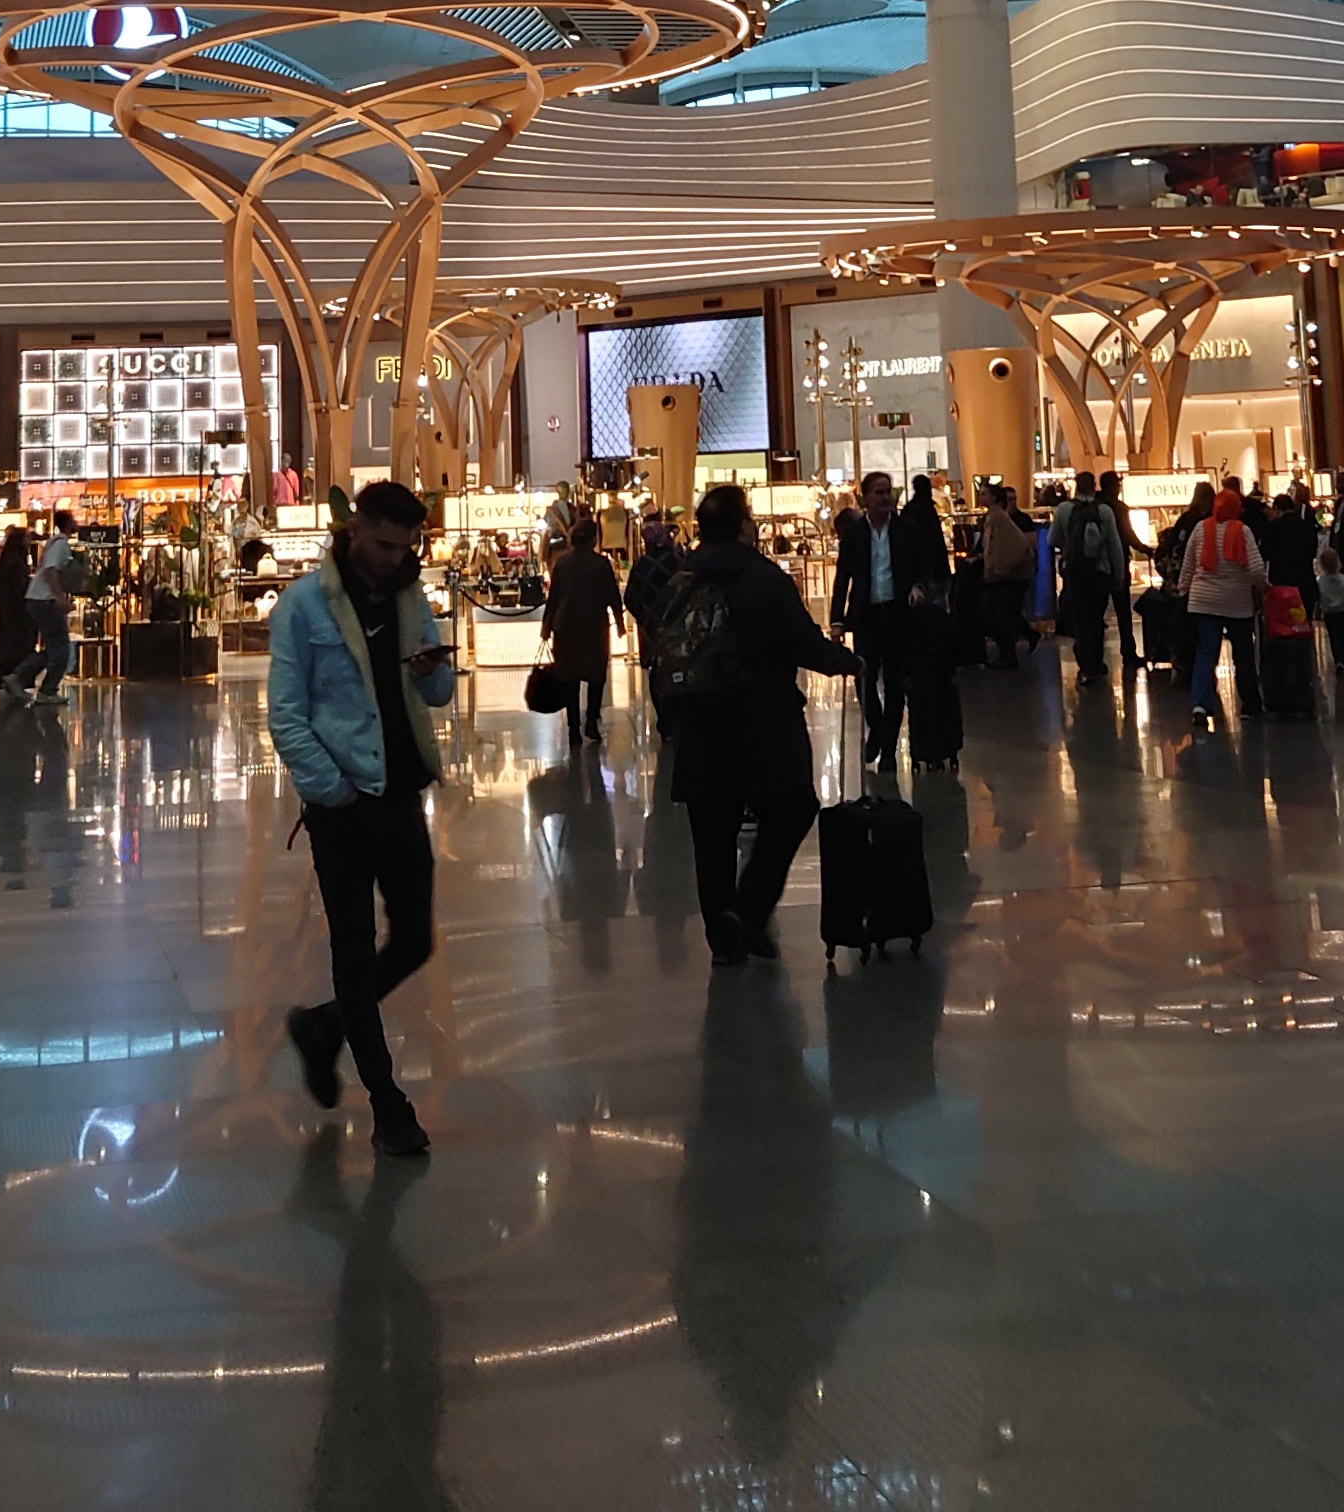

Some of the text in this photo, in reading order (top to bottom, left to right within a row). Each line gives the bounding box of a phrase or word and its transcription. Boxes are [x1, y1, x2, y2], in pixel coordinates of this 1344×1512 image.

[1190, 337, 1252, 361] ENETA
[375, 355, 452, 383] FEDI
[1146, 483, 1190, 497] LOEWE
[474, 505, 541, 518] GIVENC
